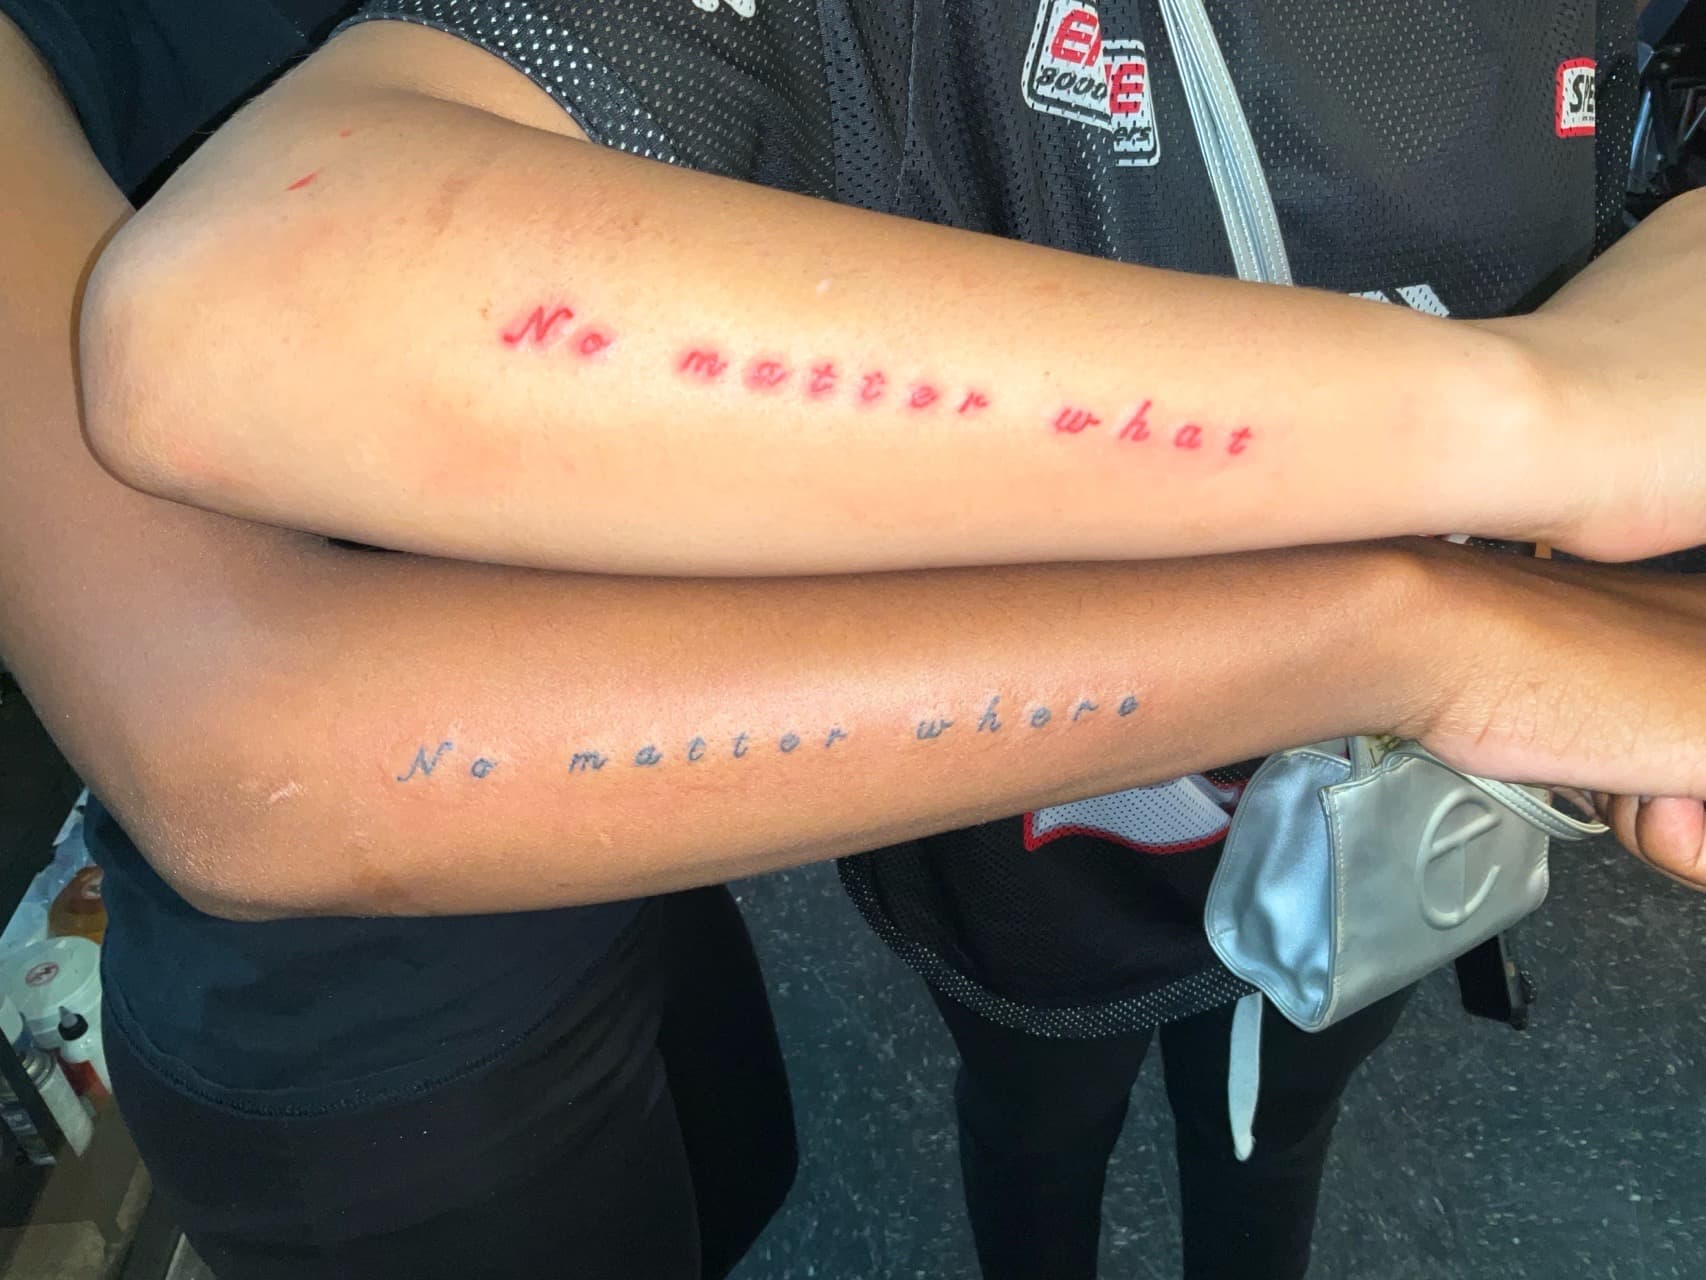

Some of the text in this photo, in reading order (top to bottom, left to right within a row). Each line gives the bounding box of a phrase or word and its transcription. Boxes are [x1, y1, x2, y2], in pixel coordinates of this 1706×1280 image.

[502, 304, 1254, 456] No matter what
[396, 695, 1140, 782] No matter where
